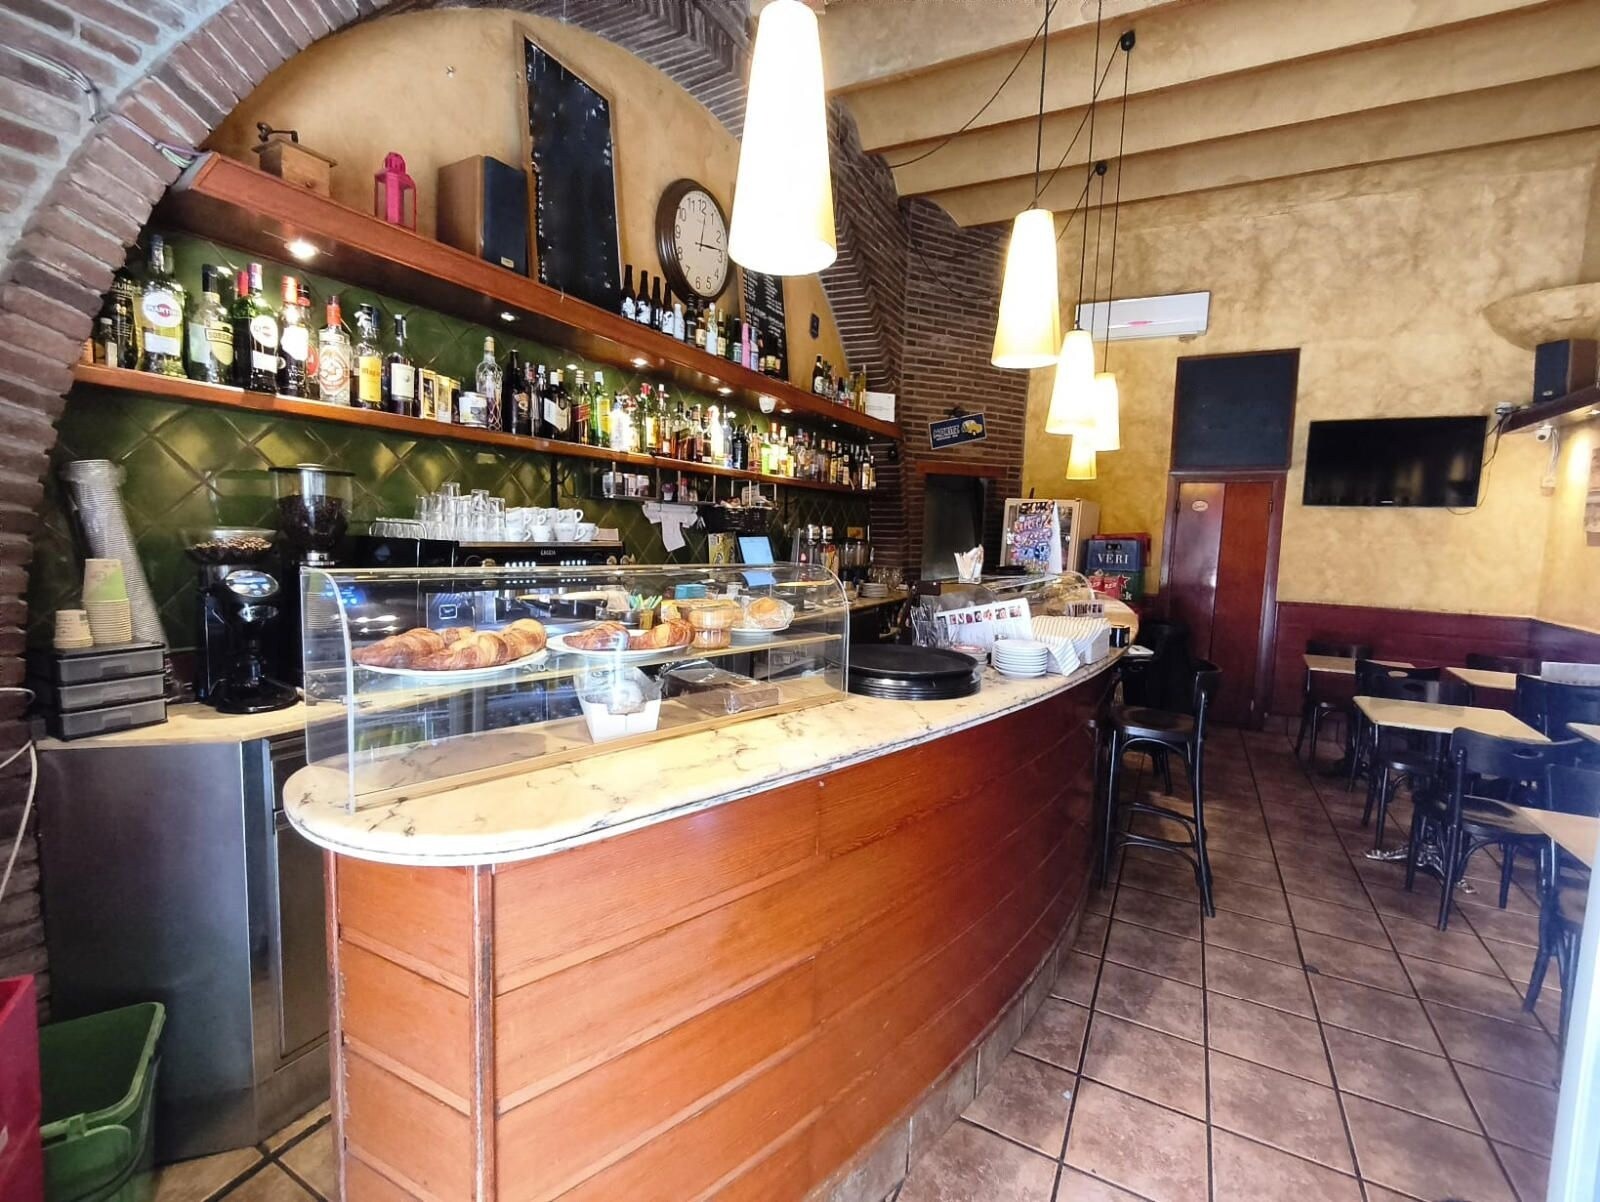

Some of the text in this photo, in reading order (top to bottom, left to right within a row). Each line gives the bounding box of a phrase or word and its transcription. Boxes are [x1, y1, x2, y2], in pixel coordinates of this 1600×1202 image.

[687, 198, 695, 213] 11
[698, 199, 707, 216] 12
[677, 206, 686, 222] 10
[675, 224, 681, 239] 9
[716, 230, 721, 243] 2
[676, 246, 683, 261] 8
[718, 249, 723, 263] 3
[685, 264, 691, 278] 7
[714, 268, 719, 281] 4
[695, 276, 701, 290] 6
[706, 276, 712, 290] 5
[1097, 553, 1129, 564] VERI
